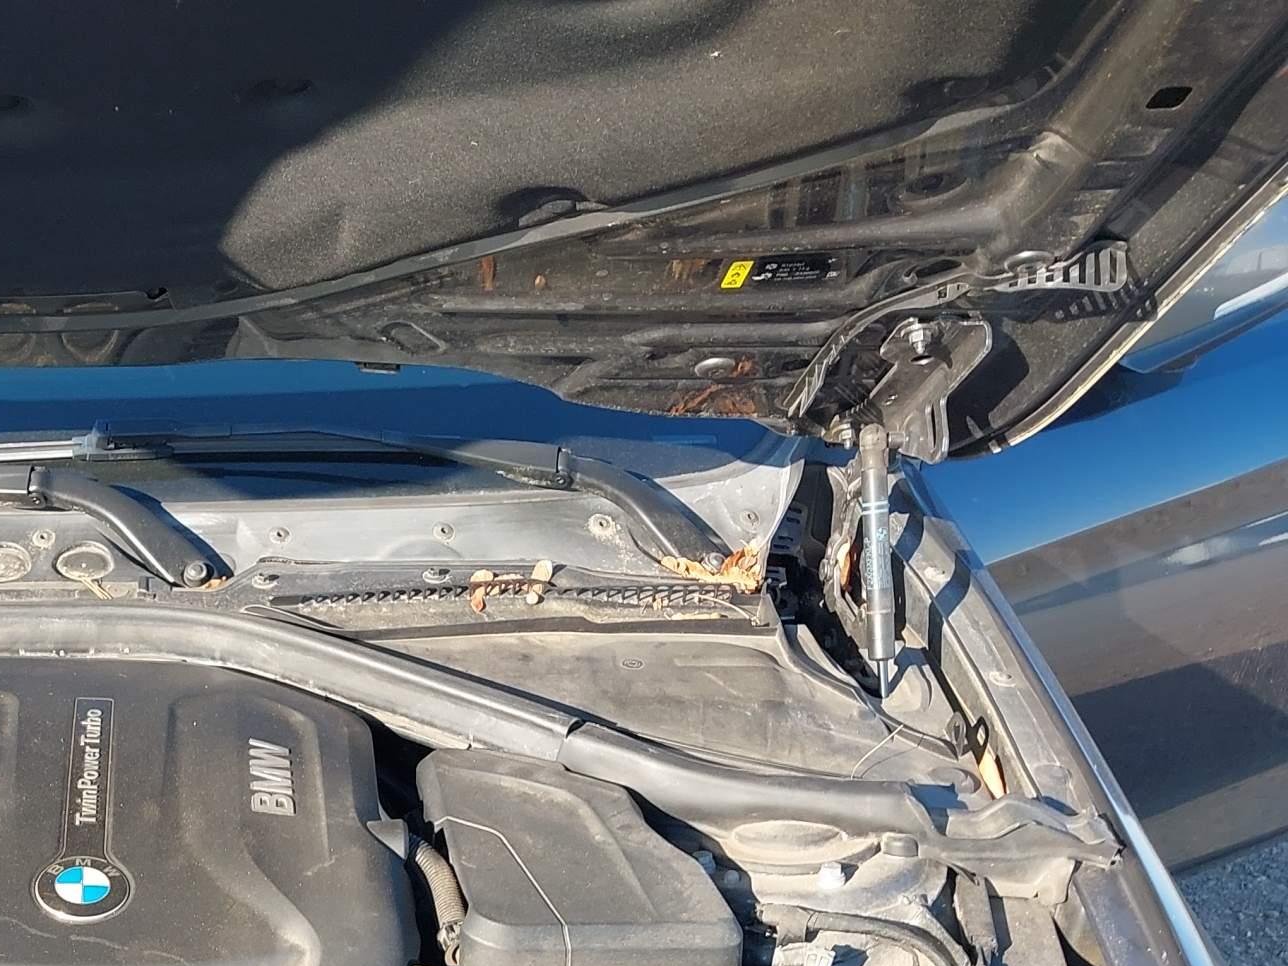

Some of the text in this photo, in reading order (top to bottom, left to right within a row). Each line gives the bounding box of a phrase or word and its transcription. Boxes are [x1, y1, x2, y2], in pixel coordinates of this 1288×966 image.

[75, 708, 103, 826] TwinPower Turbo
[249, 737, 295, 816] BMW
